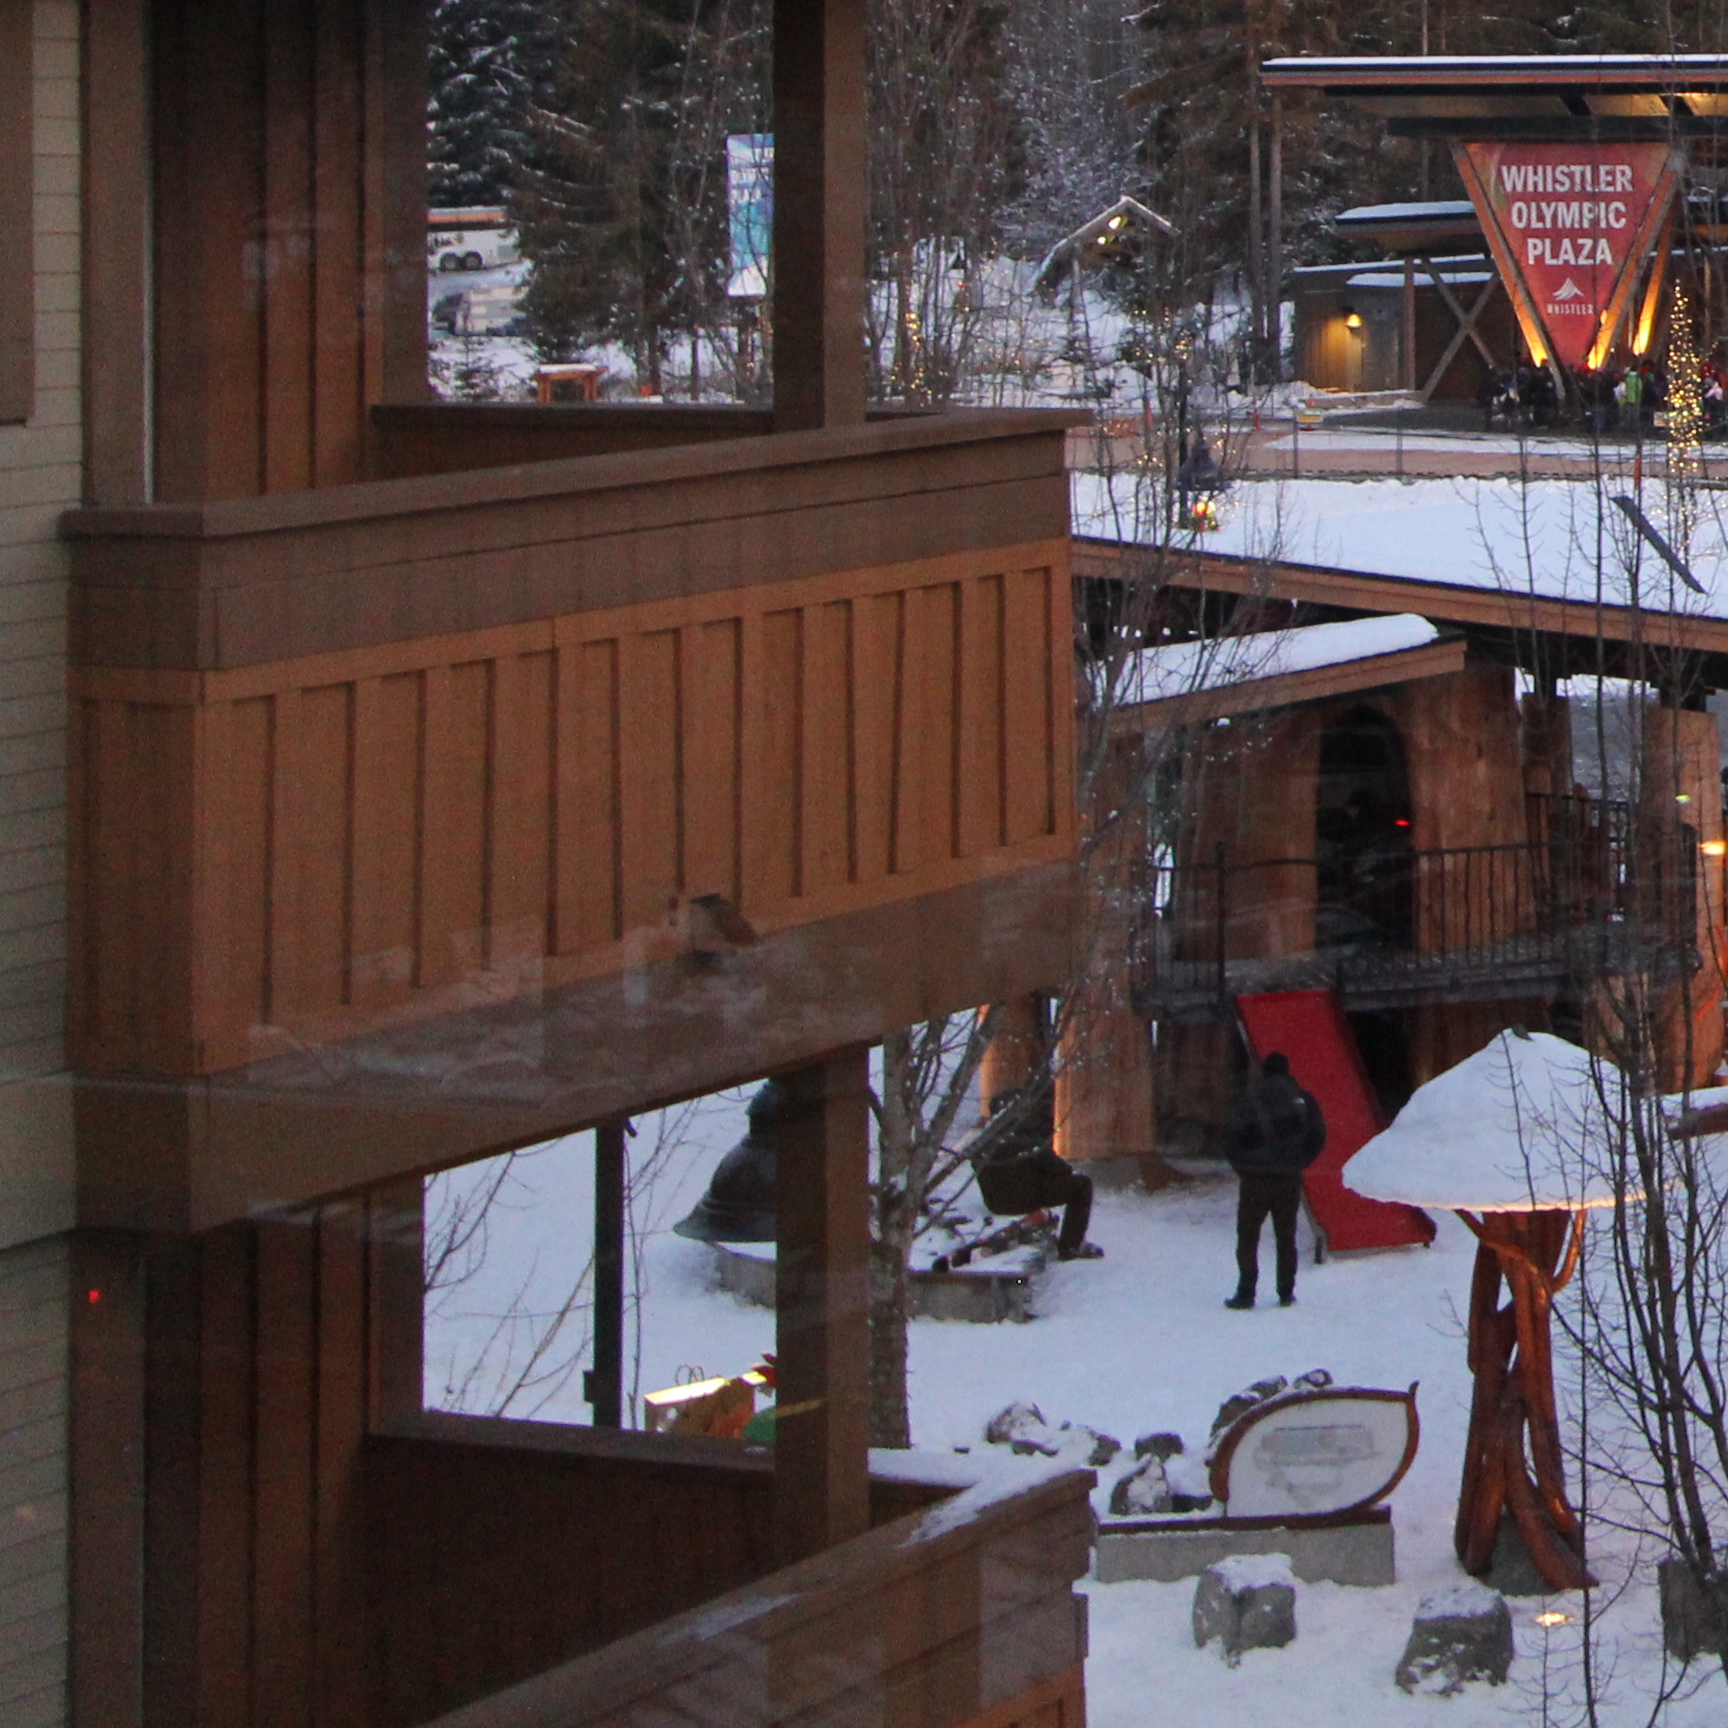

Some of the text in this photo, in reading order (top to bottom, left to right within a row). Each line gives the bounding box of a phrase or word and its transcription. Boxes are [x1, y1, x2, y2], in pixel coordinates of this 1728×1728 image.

[1501, 164, 1634, 193] WHISTLER
[1511, 200, 1627, 230] OLYMPIC
[1527, 238, 1613, 265] PLAZA
